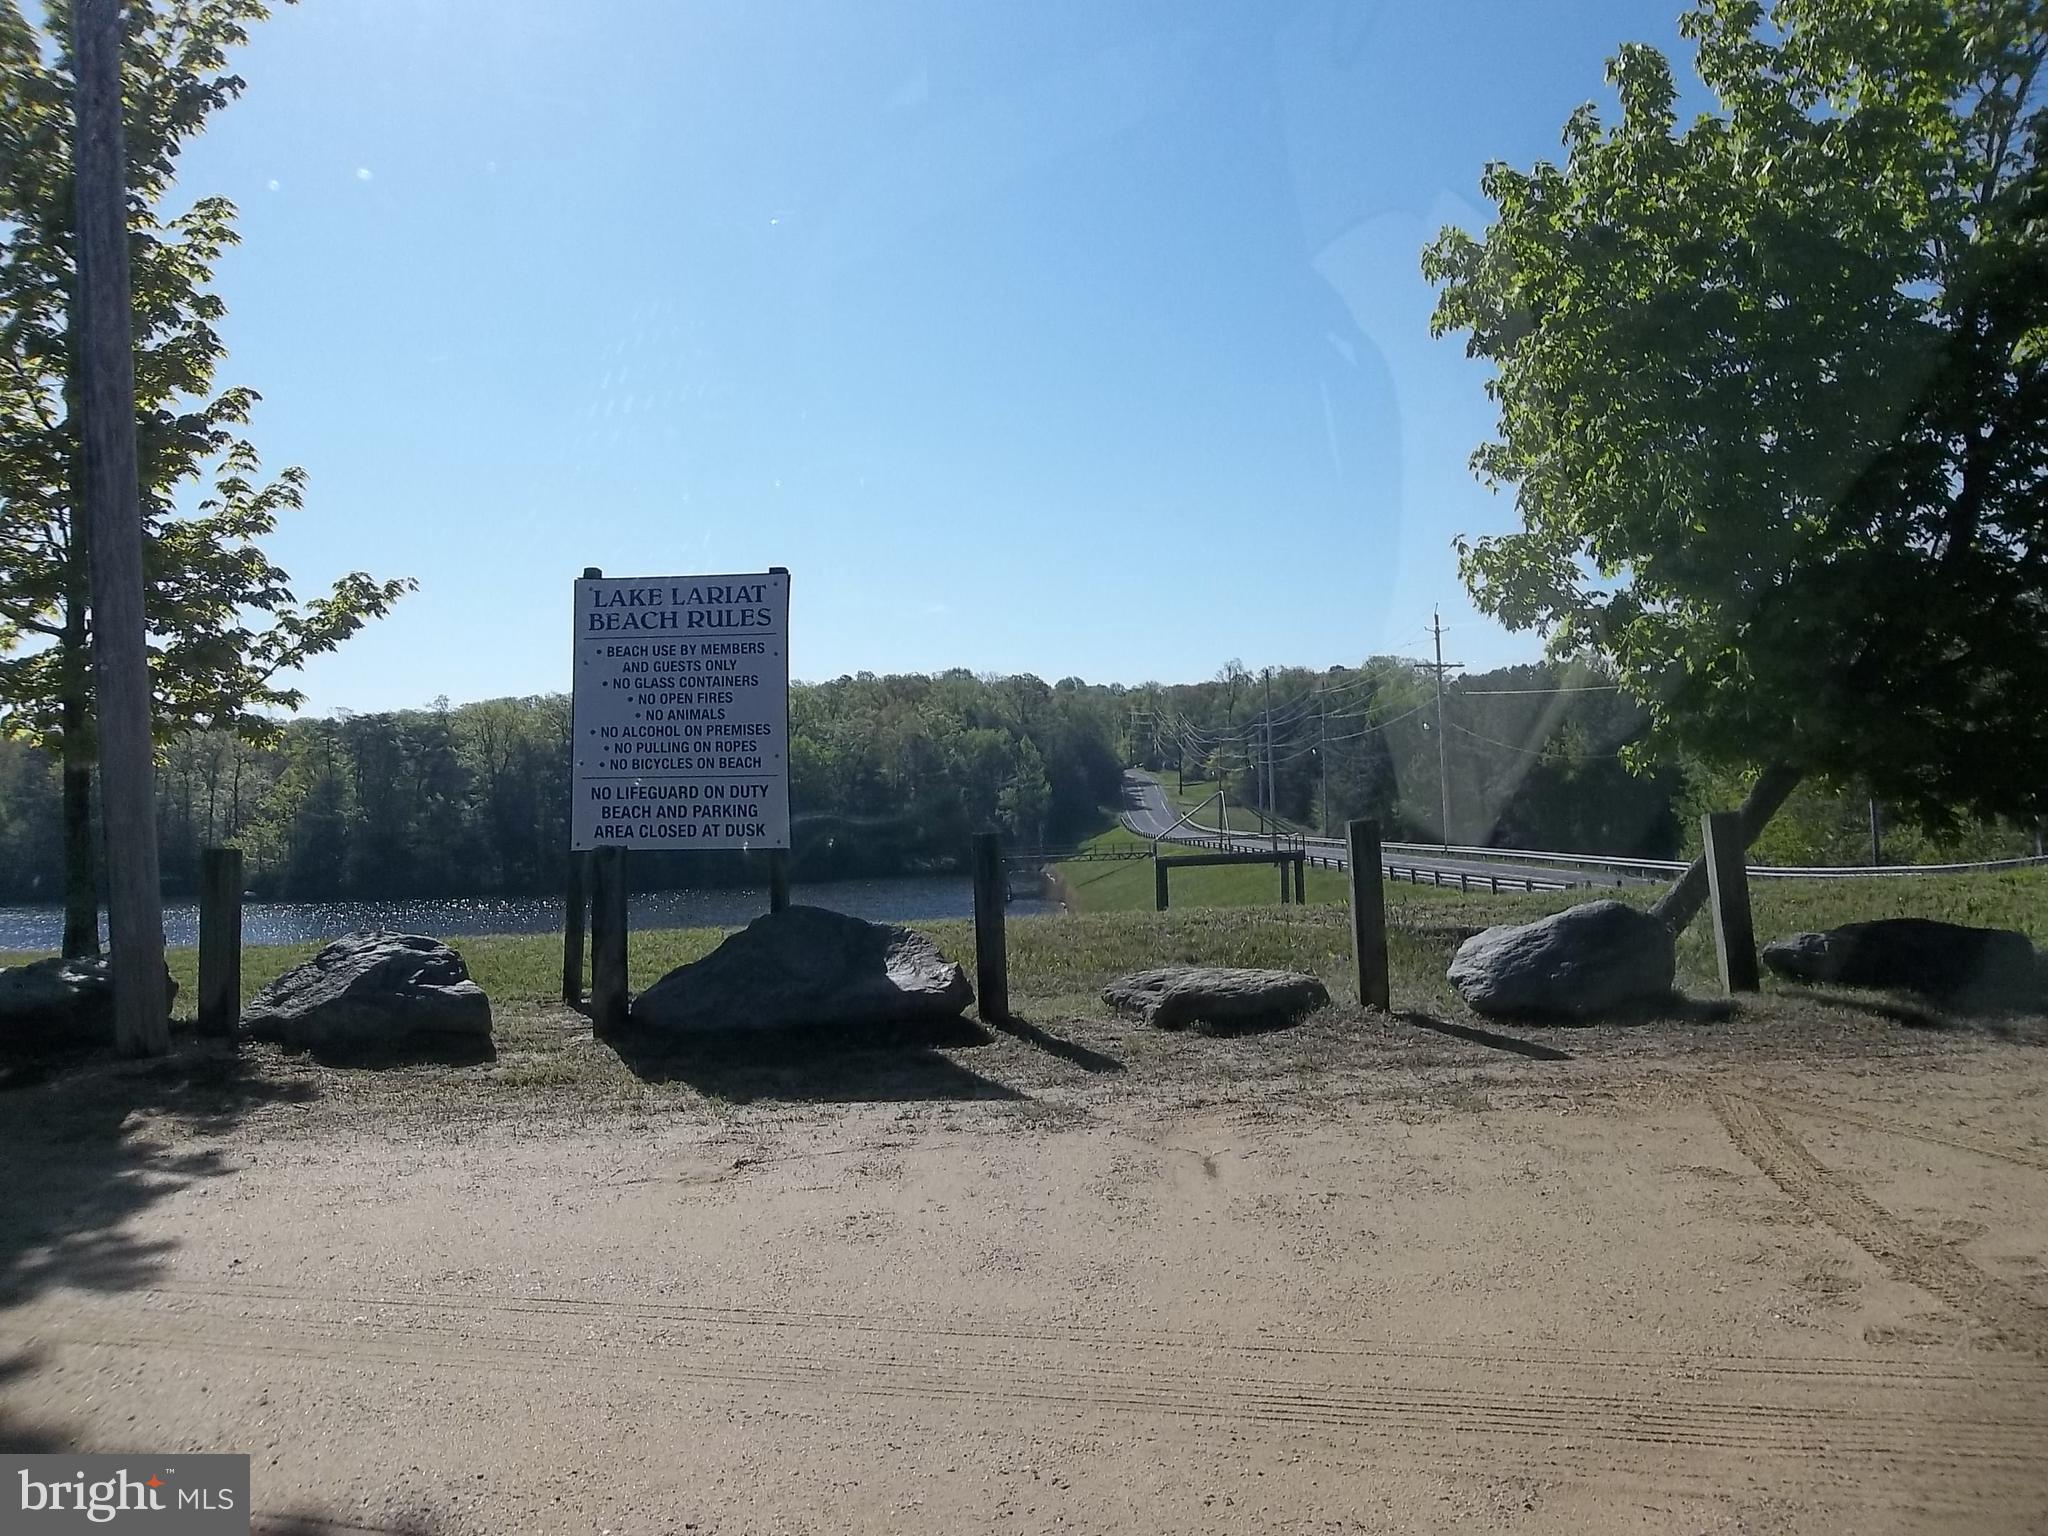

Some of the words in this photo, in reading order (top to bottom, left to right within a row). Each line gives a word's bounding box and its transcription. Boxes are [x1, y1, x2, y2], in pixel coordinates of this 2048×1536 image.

[594, 588, 662, 607] LAKE
[672, 585, 766, 605] LARIAT
[589, 611, 678, 631] BEACH
[688, 608, 771, 628] RULES
[607, 645, 649, 657] BEACH
[653, 644, 676, 656] USE
[680, 644, 696, 655] BY
[701, 643, 765, 654] MEMBERS
[623, 661, 649, 673] AND
[653, 660, 701, 672] GUESTS
[706, 660, 737, 670] ONLY
[613, 678, 630, 689] NO
[635, 676, 675, 688] GLASS
[680, 675, 758, 687] CONTAINERS
[639, 694, 655, 704] NO
[660, 693, 692, 704] OPEN
[698, 692, 733, 703] FIRES
[646, 709, 663, 720] NO
[667, 709, 725, 720] ANIMALS
[601, 726, 618, 737] NO
[622, 725, 680, 737] ALCOHOL
[685, 725, 701, 736] ON
[707, 724, 771, 736] PREMISES
[615, 743, 632, 753] NO
[637, 741, 689, 753] PULLING
[694, 741, 711, 752] ON
[716, 741, 757, 752] ROPES
[610, 759, 627, 770] NO
[632, 758, 693, 769] BICYCLES
[698, 758, 715, 768] ON
[719, 757, 761, 768] BEACH
[591, 787, 611, 799] NO
[617, 786, 698, 799] LIFEGUARD
[705, 785, 725, 798] ON
[730, 785, 768, 798] DUTY
[602, 806, 650, 819] BEACH
[657, 805, 687, 818] AND
[693, 804, 758, 817] PARKING
[594, 825, 634, 838] AREA
[639, 824, 697, 838] CLOSED
[702, 824, 720, 837] AT
[725, 823, 766, 837] DUSK
